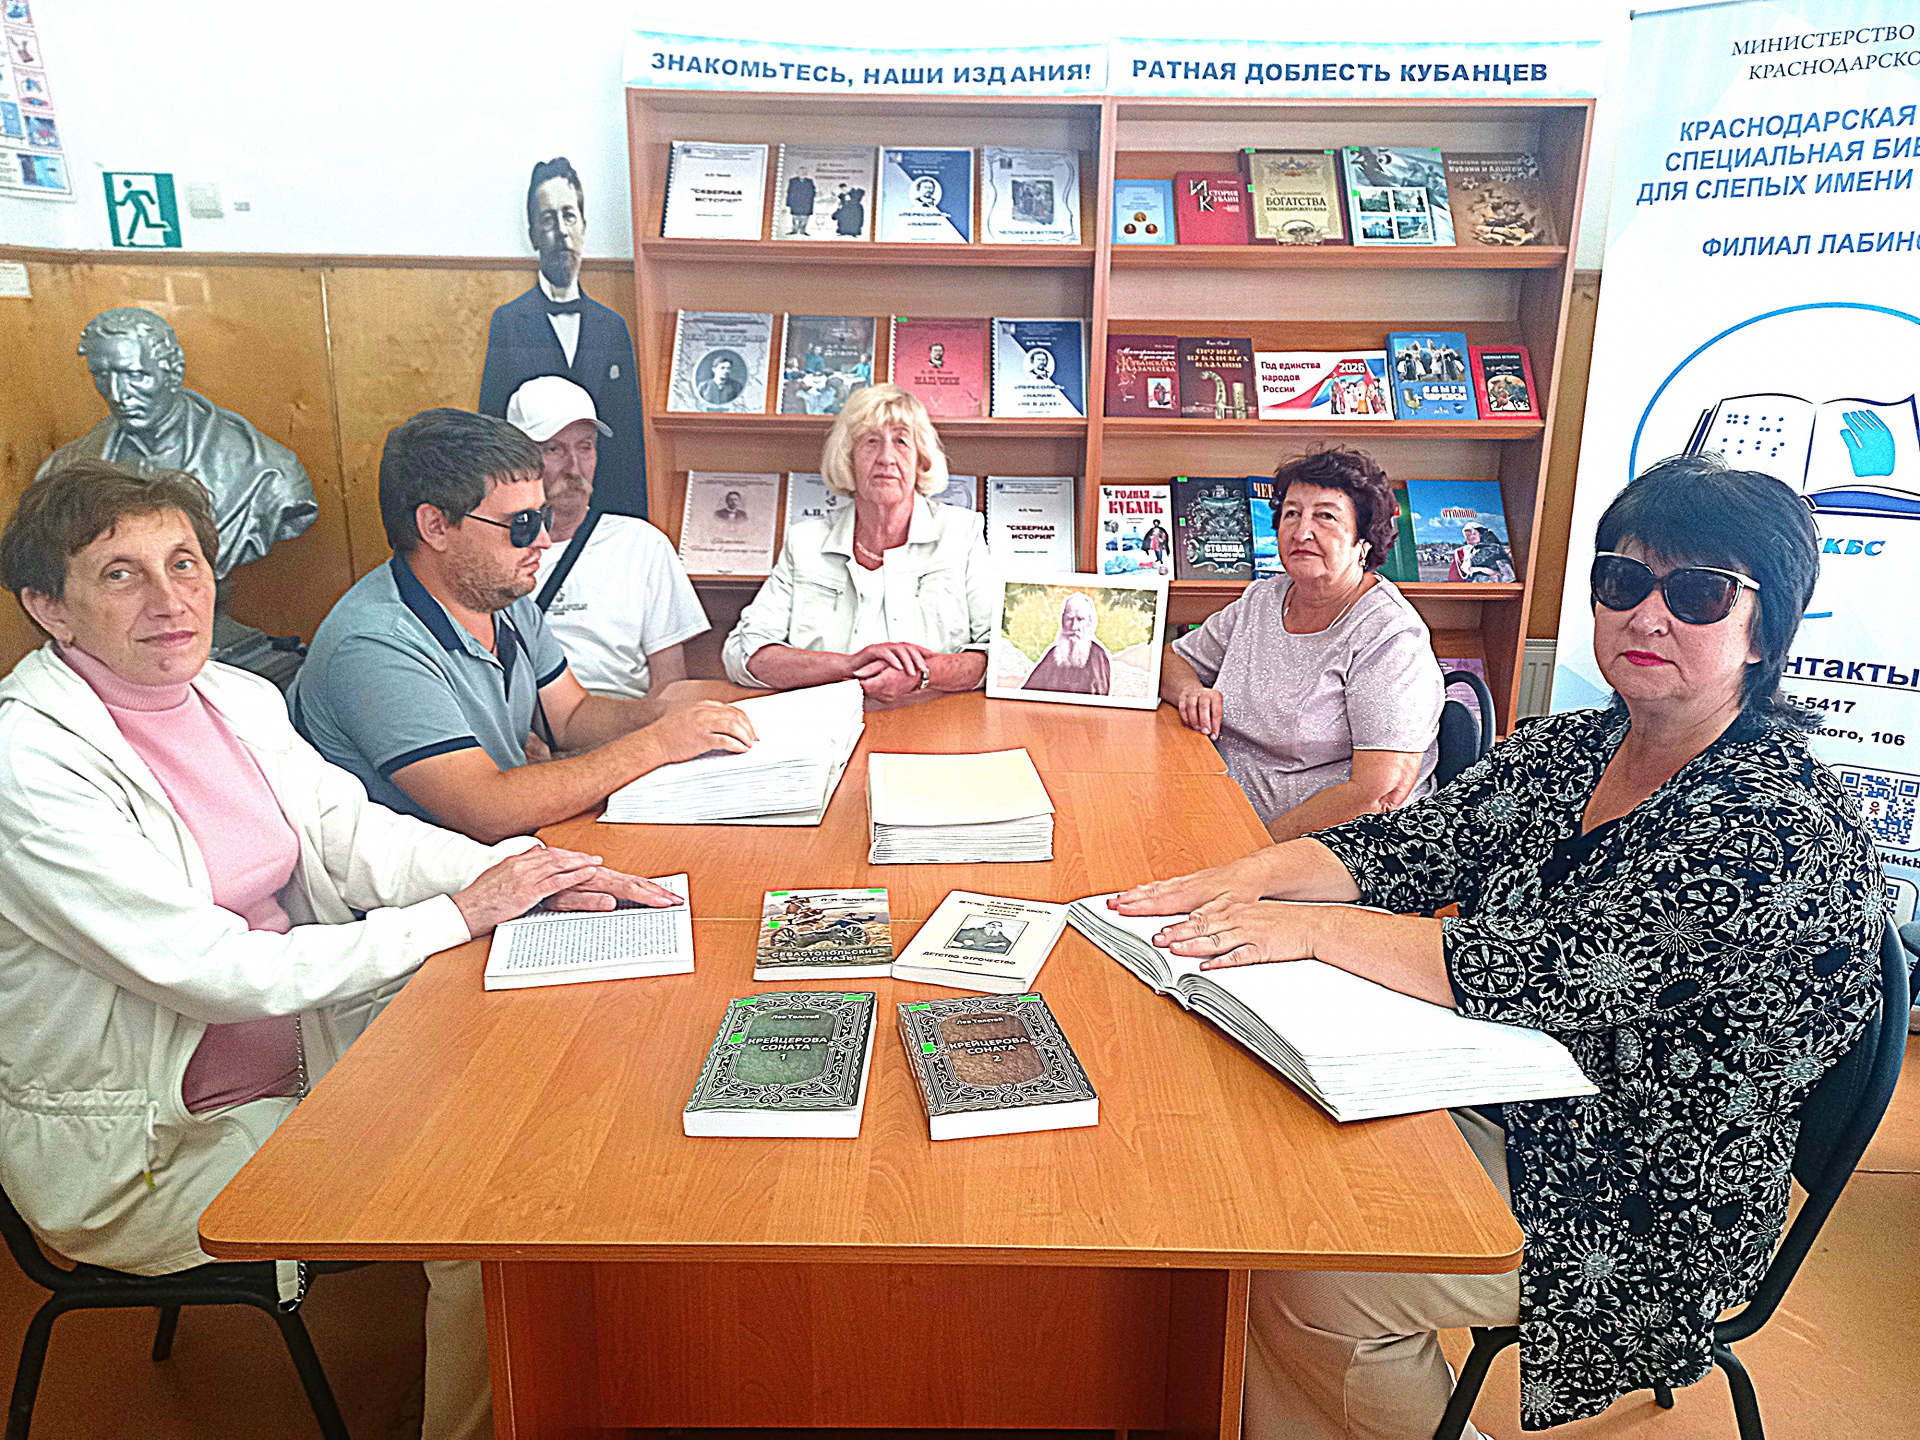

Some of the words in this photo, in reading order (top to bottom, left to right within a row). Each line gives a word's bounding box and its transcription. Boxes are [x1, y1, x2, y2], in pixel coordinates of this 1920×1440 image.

[1731, 24, 1915, 56] МИНИСТЕРСТВО
[651, 52, 854, 87] ЗНАКОМЬТЕСЬ,
[864, 68, 943, 85] НАШИ
[953, 63, 1092, 87] ИЗДАНИЯ!
[1133, 59, 1236, 81] РАТНАЯ
[1245, 63, 1391, 85] ДОБЛЕСТЬ
[1400, 63, 1548, 85] КУБАНЦЕВ
[1748, 50, 1920, 80] КРАСНОДАРСКО
[1679, 104, 1917, 142] КРАСНОДАРСКАЯ
[1665, 140, 1864, 172] СПЕЦИАЛЬНАЯ
[1636, 181, 1688, 206] ДЛЯ
[1695, 174, 1808, 200] СЛЕПЫХ
[1815, 168, 1913, 194] ИМЕНИ
[1265, 196, 1327, 207] БОГАТСТВА
[1702, 234, 1811, 257] ФИЛИАЛ
[1818, 231, 1920, 254] ЛАБИН
[1261, 361, 1277, 370] Год
[1279, 362, 1321, 370] единства
[1339, 362, 1366, 374] 2026
[1262, 373, 1300, 382] народов
[1263, 385, 1296, 393] России
[1115, 490, 1150, 499] РОДНАЯ
[1253, 482, 1275, 498] ЧЕР
[1109, 500, 1164, 516] КУБАНЬ
[1817, 537, 1886, 556] КБС
[1783, 656, 1920, 688] нтакты
[1786, 694, 1857, 714] 5-5417
[1871, 731, 1906, 746] 106
[771, 948, 880, 958] СЕВАСТОПОЛЬСКИЕ
[797, 955, 857, 963] РАССКАЗЫ
[962, 955, 1016, 965] ОТРОЧЕСТВО
[971, 1016, 1005, 1024] Толстой
[747, 1036, 828, 1045] КРЕЙЦЕРОВА
[948, 1036, 1030, 1050] КРЕЙЦЕРОВА
[966, 1044, 1017, 1055] СОНАТА
[780, 1053, 787, 1061] 1
[992, 1055, 1002, 1063] 2
